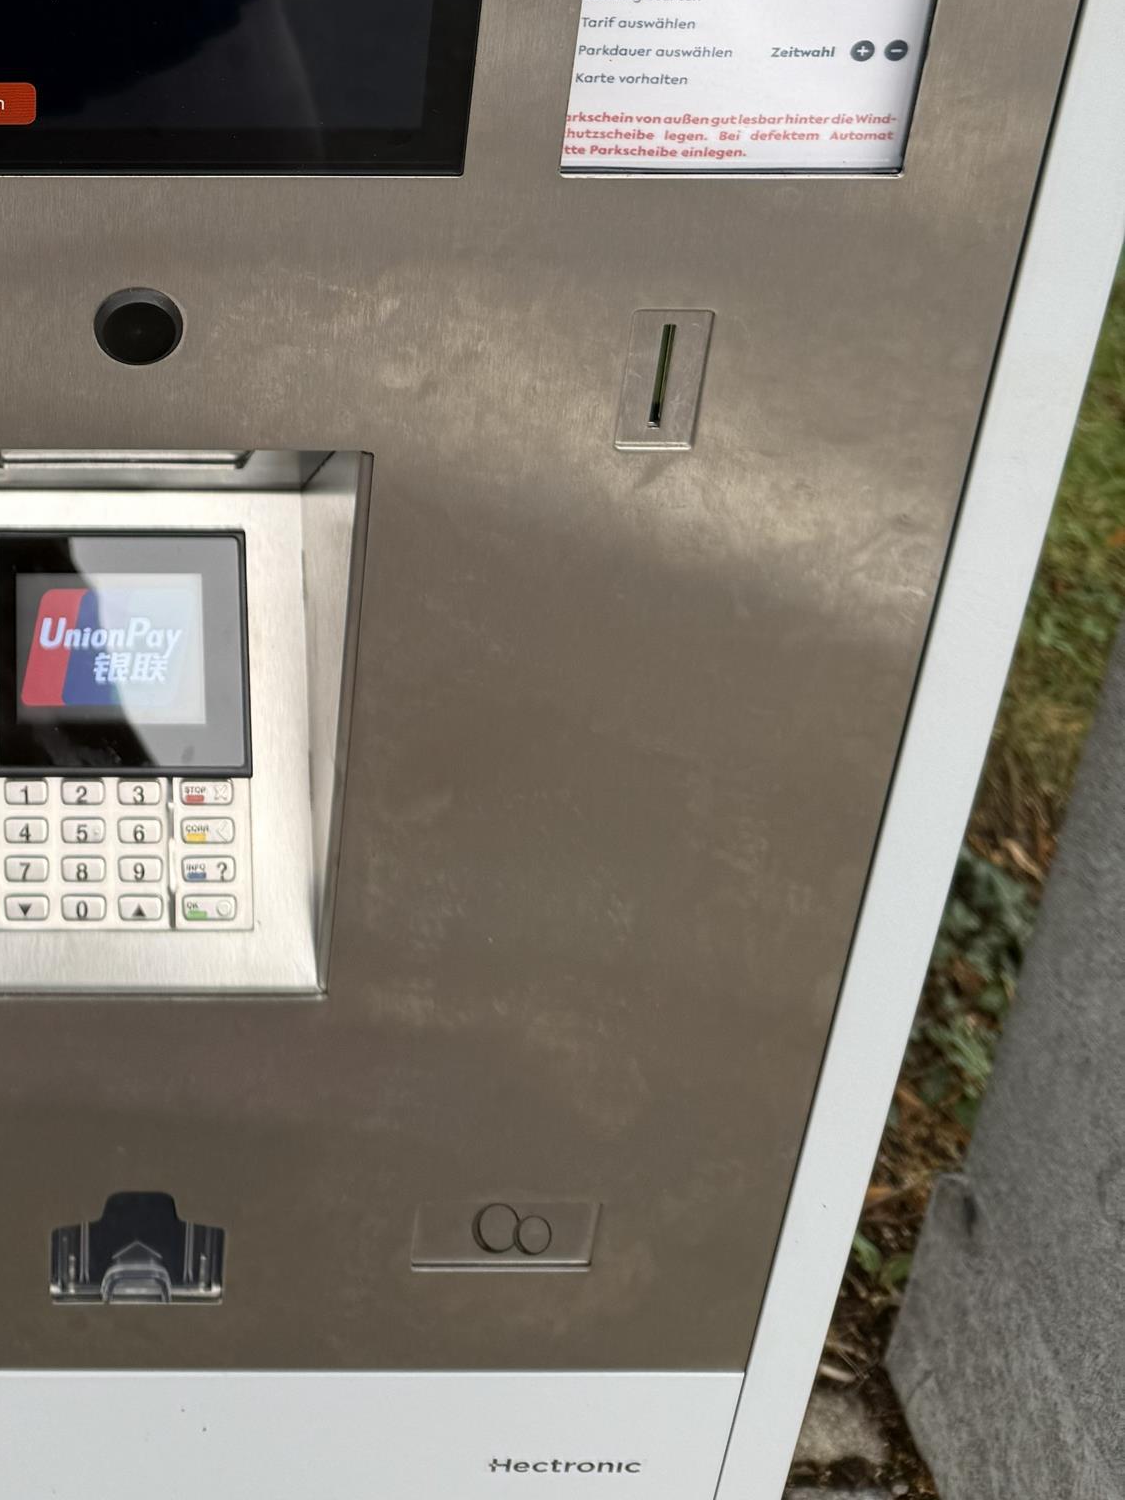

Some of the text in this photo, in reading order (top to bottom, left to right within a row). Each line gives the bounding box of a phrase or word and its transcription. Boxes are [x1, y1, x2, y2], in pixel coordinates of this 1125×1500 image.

[581, 17, 695, 29] Tarif auswählen
[578, 45, 835, 58] Parkdauer auswählen Zeitwahl
[575, 73, 688, 85] Karte vorhalten
[566, 112, 897, 128] arkschein von außen gut lesbar hinter die Wind-
[565, 129, 894, 144] hutzscheibe legen. Bei defektem Automat
[590, 146, 747, 160] Parkscheibe einlegen.
[39, 617, 182, 658] UnionPay
[93, 652, 169, 684] 银联
[76, 786, 87, 803] 2
[132, 786, 144, 804] 3
[76, 824, 87, 842] 5
[76, 863, 88, 881] 8
[76, 901, 88, 919] 0
[489, 1458, 641, 1473] Hectronic
